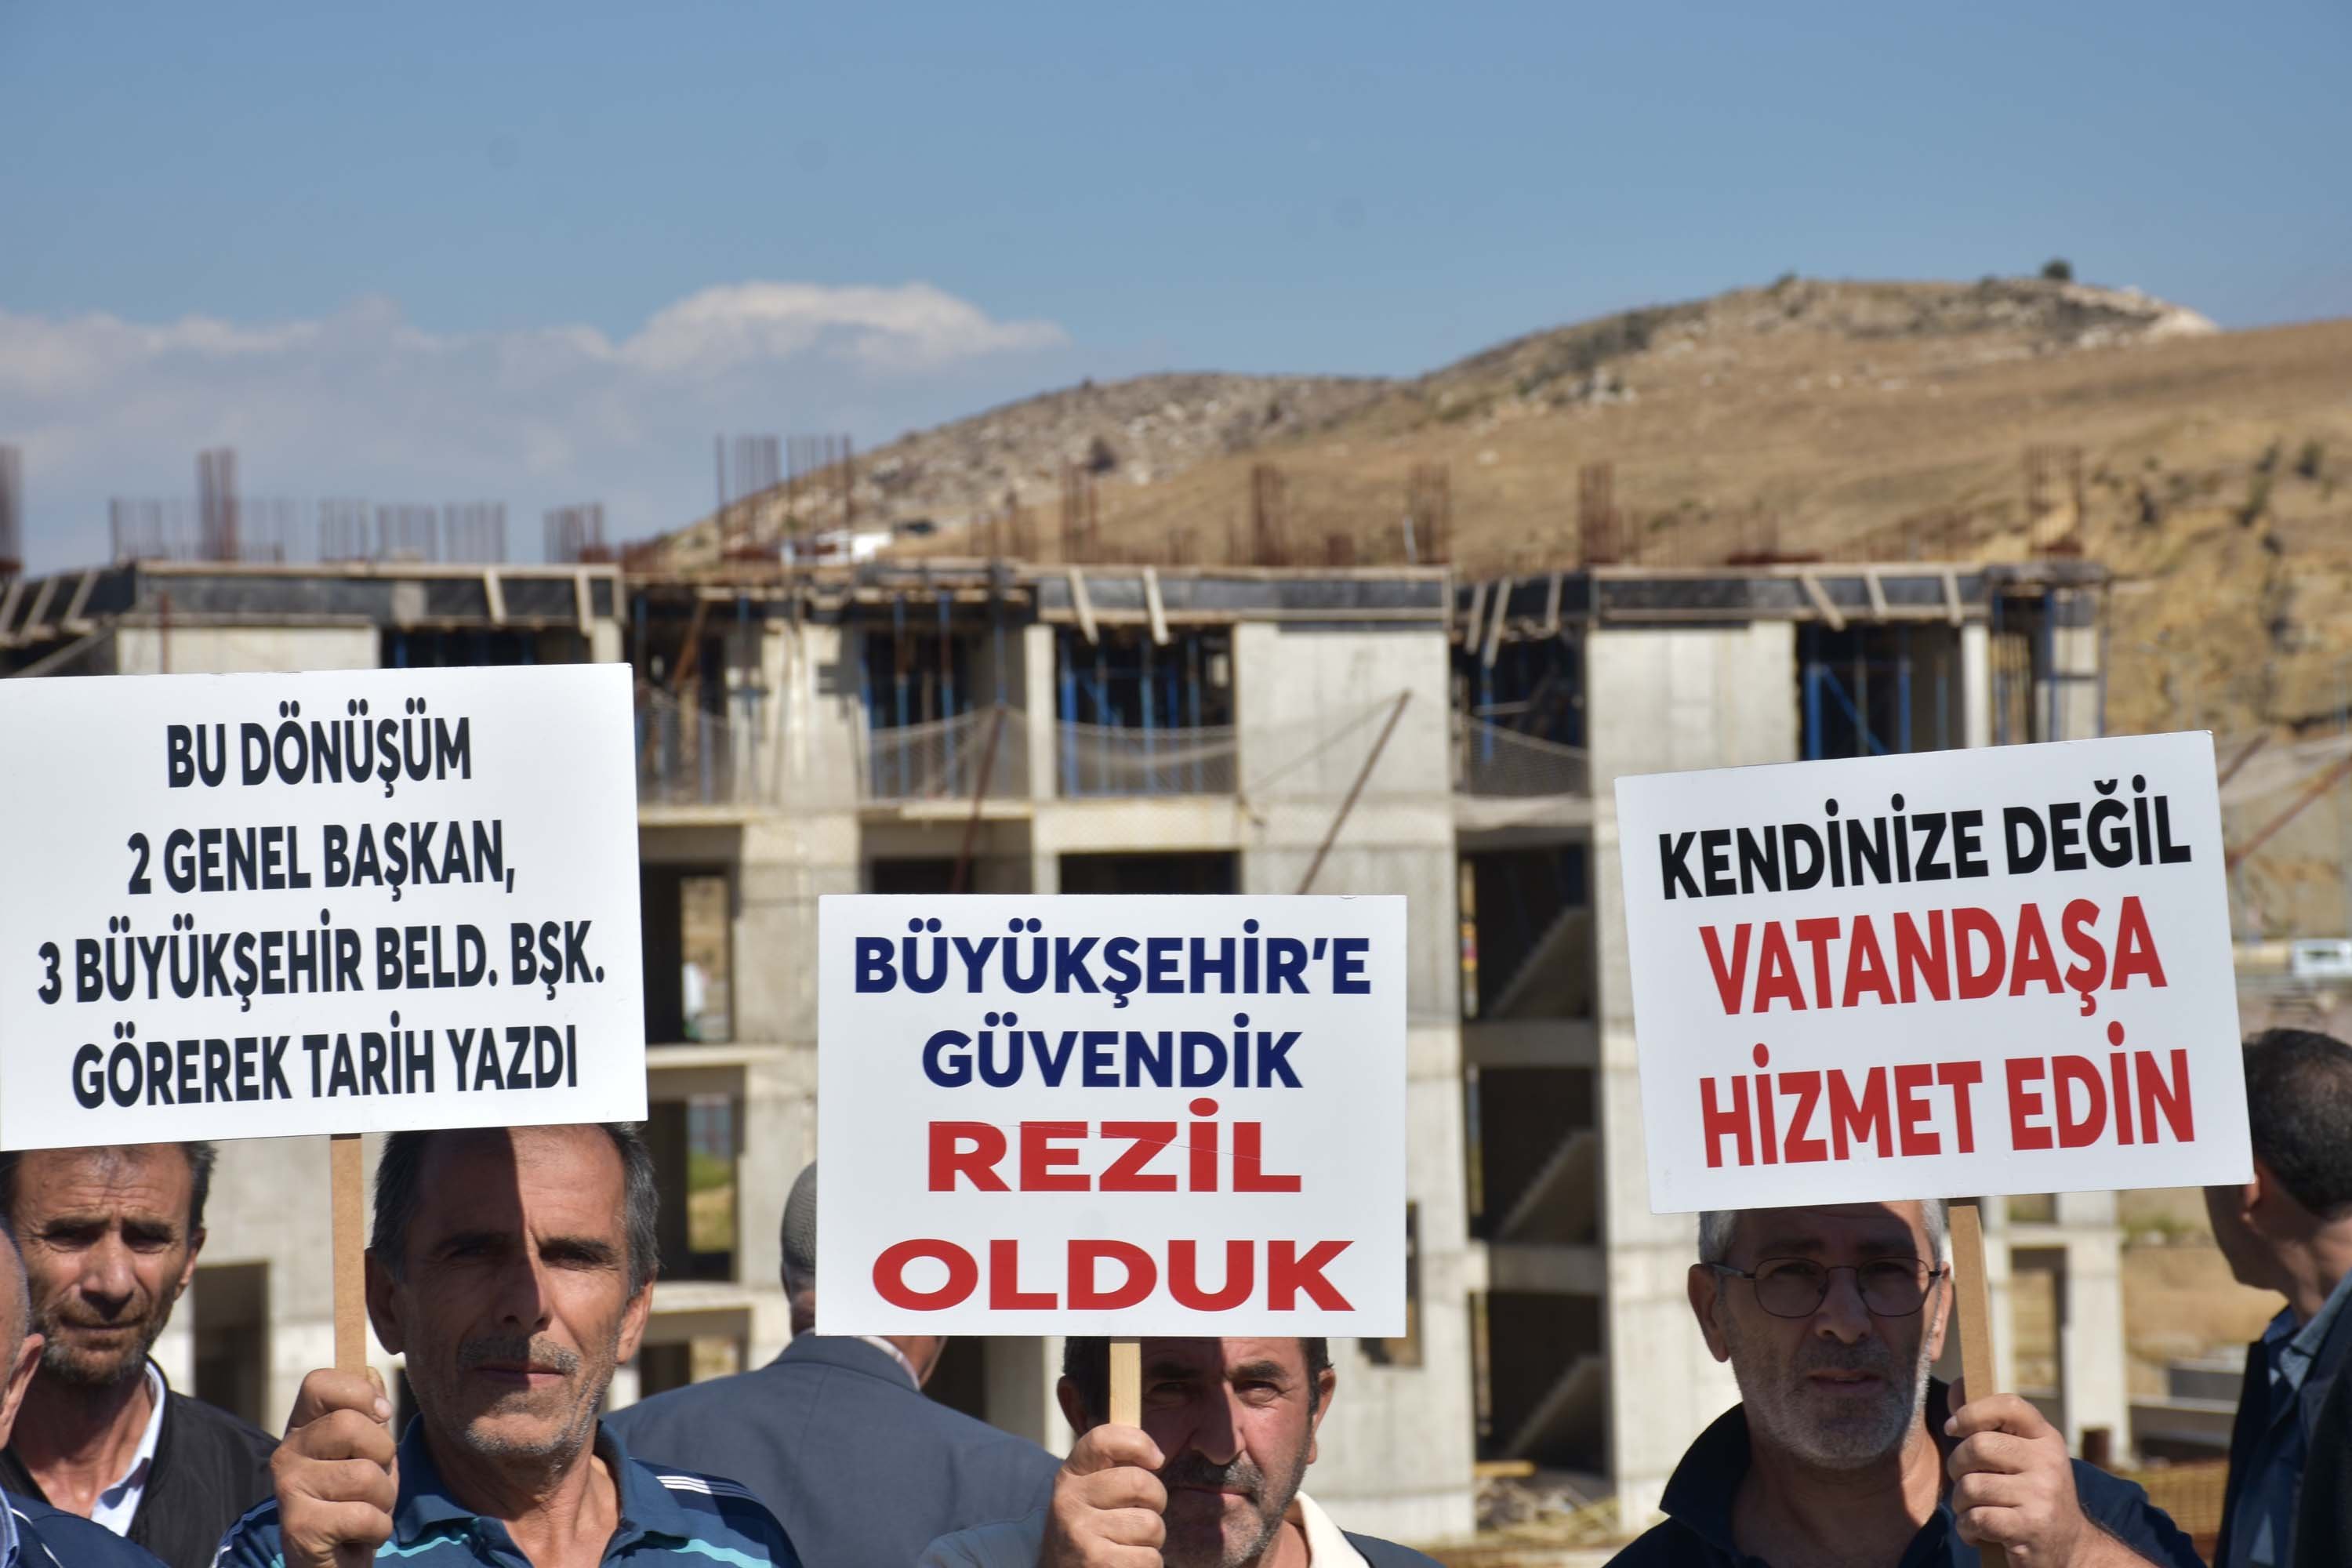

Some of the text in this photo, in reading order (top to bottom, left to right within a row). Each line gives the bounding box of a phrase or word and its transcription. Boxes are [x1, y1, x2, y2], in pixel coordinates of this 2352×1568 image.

[168, 698, 470, 797] BU DÖNÜŞÜM
[128, 820, 514, 902] 2 GENEL BAŞKAN,
[1660, 775, 2191, 899] KENDİNİZE DEĞİL
[38, 909, 604, 1012] 3 BÜYÜKŞEHİR BELD. BŞK.
[1699, 896, 2167, 1016] VATANDAŞA
[73, 1011, 576, 1109] GÖREREK TARİH YAZDI
[923, 1012, 1303, 1087] GÜVENDİK
[1700, 1022, 2194, 1167] HİZMET EDİN
[929, 1098, 1301, 1192] REZİL
[873, 1239, 1355, 1311] OLDUK
